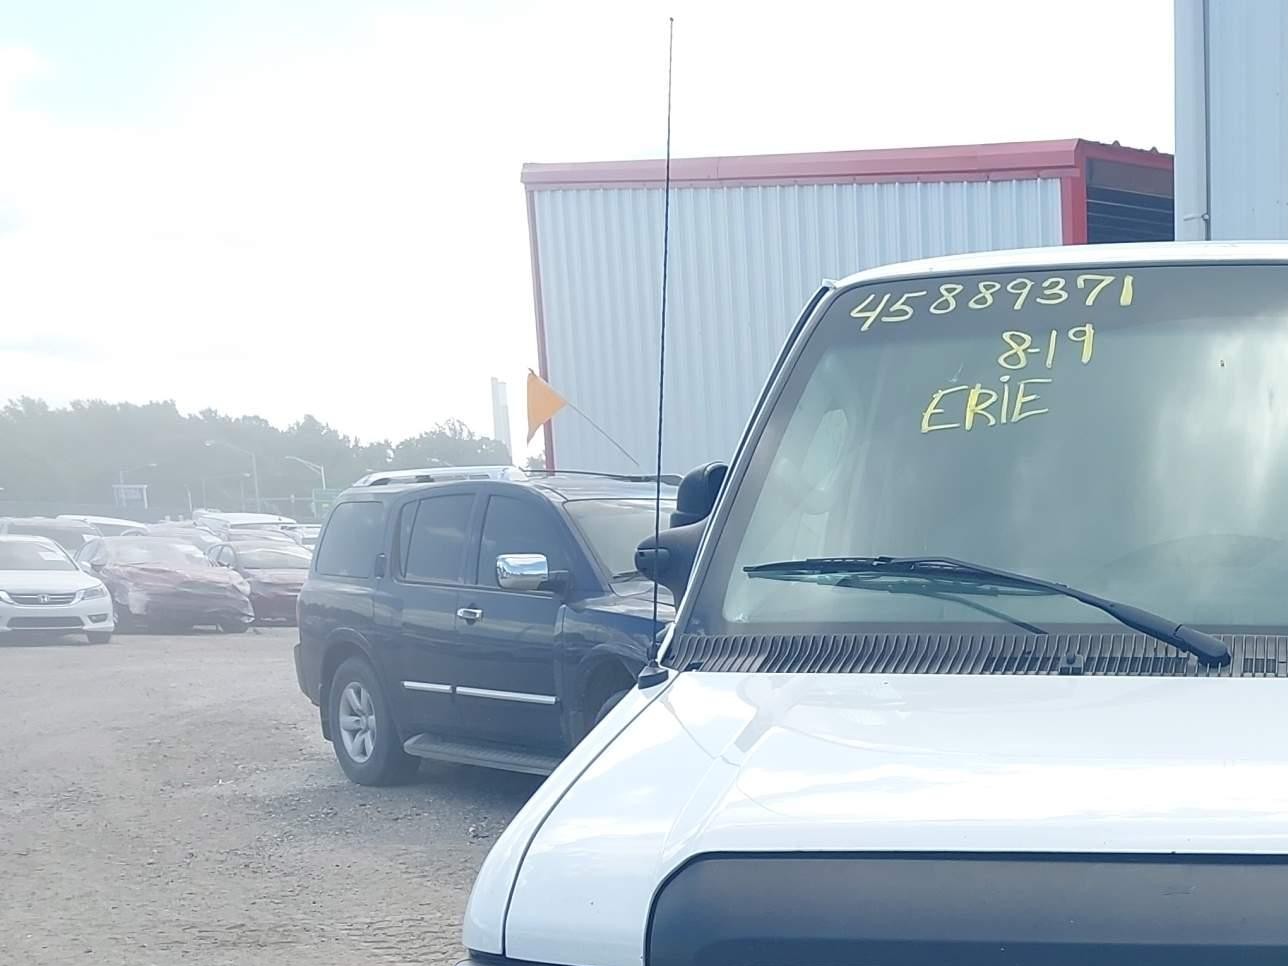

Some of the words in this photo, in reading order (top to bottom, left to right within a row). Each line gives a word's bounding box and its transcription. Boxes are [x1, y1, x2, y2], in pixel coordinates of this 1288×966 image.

[850, 275, 1134, 332] 45889371
[998, 323, 1095, 369] 8-19
[920, 375, 1052, 433] ERIE
